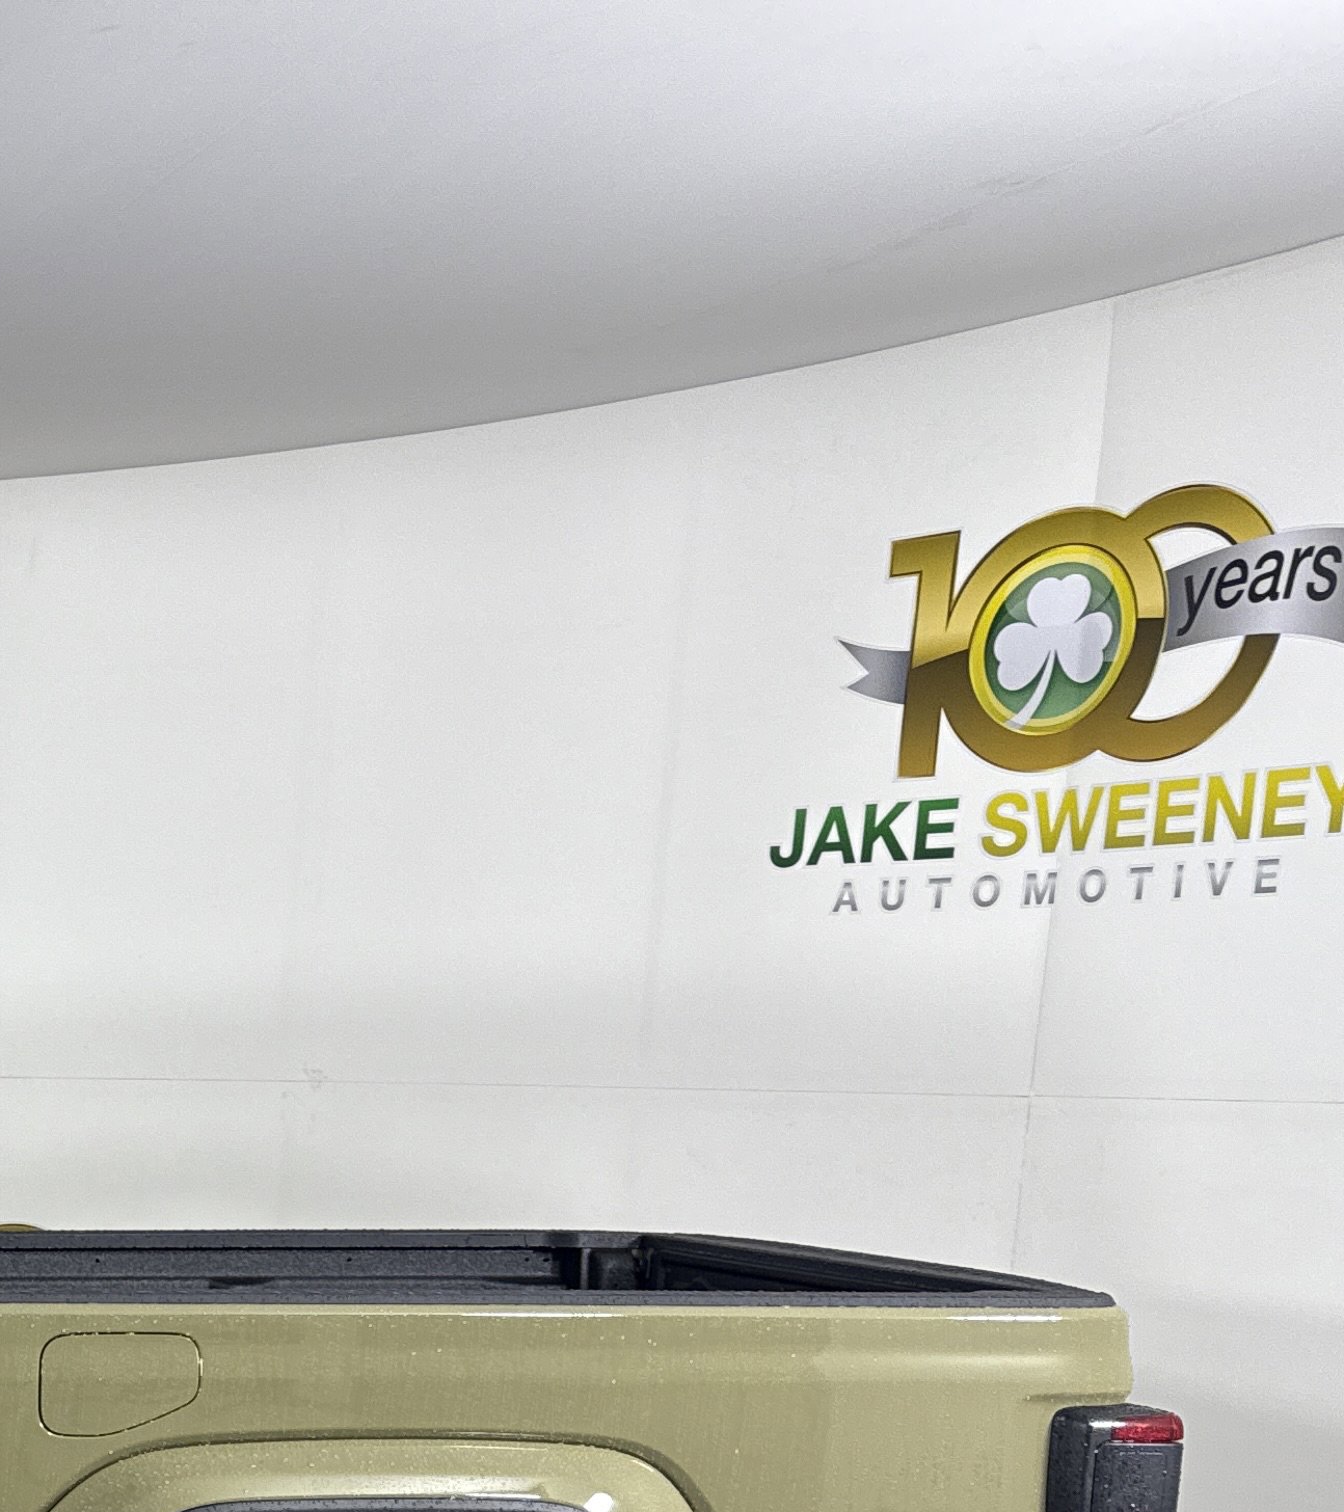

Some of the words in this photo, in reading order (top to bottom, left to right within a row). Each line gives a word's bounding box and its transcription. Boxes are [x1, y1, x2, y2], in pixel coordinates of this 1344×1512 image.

[889, 483, 1280, 779] 100
[1177, 544, 1342, 637] years
[770, 797, 960, 868] JAKE
[832, 858, 1281, 914] AUTOMOTIVE
